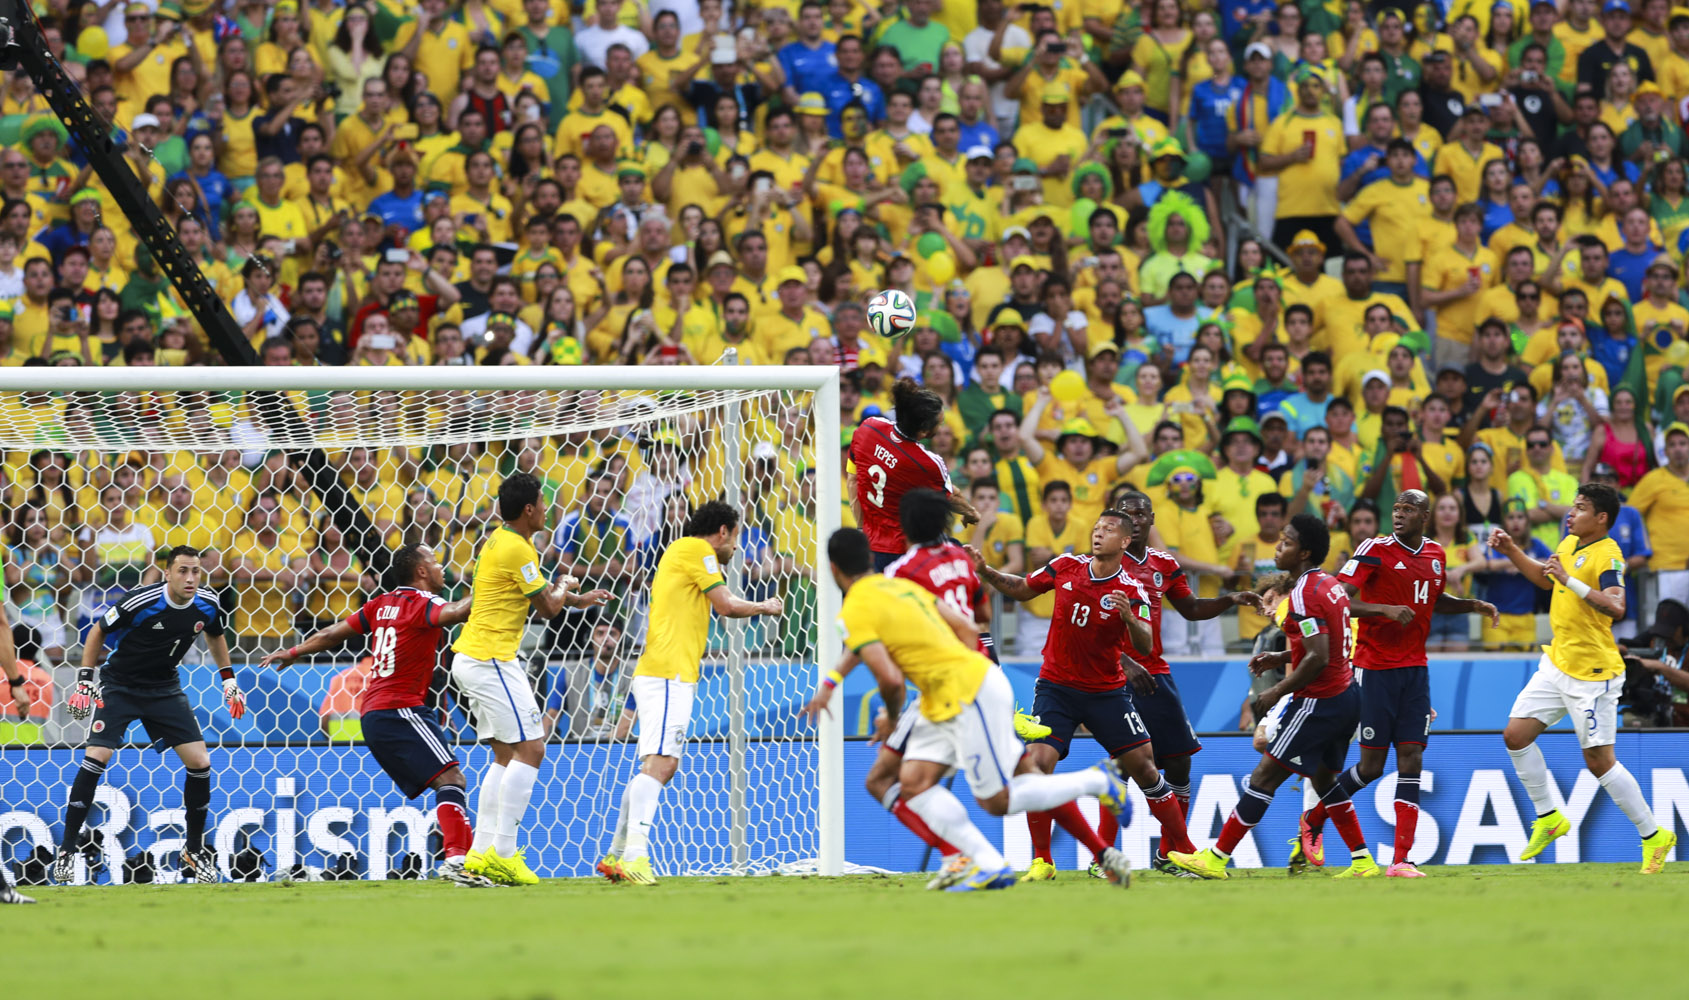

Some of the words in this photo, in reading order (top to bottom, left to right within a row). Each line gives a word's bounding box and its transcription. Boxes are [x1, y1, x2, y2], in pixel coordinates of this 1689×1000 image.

[874, 444, 898, 469] YEPES
[867, 464, 887, 509] 3
[1413, 580, 1429, 604] 14
[1071, 602, 1091, 627] 13
[169, 639, 181, 656] 1
[1124, 711, 1145, 735] 13
[1585, 709, 1597, 730] 3
[968, 754, 981, 780] 7
[1374, 769, 1600, 866] SAY
